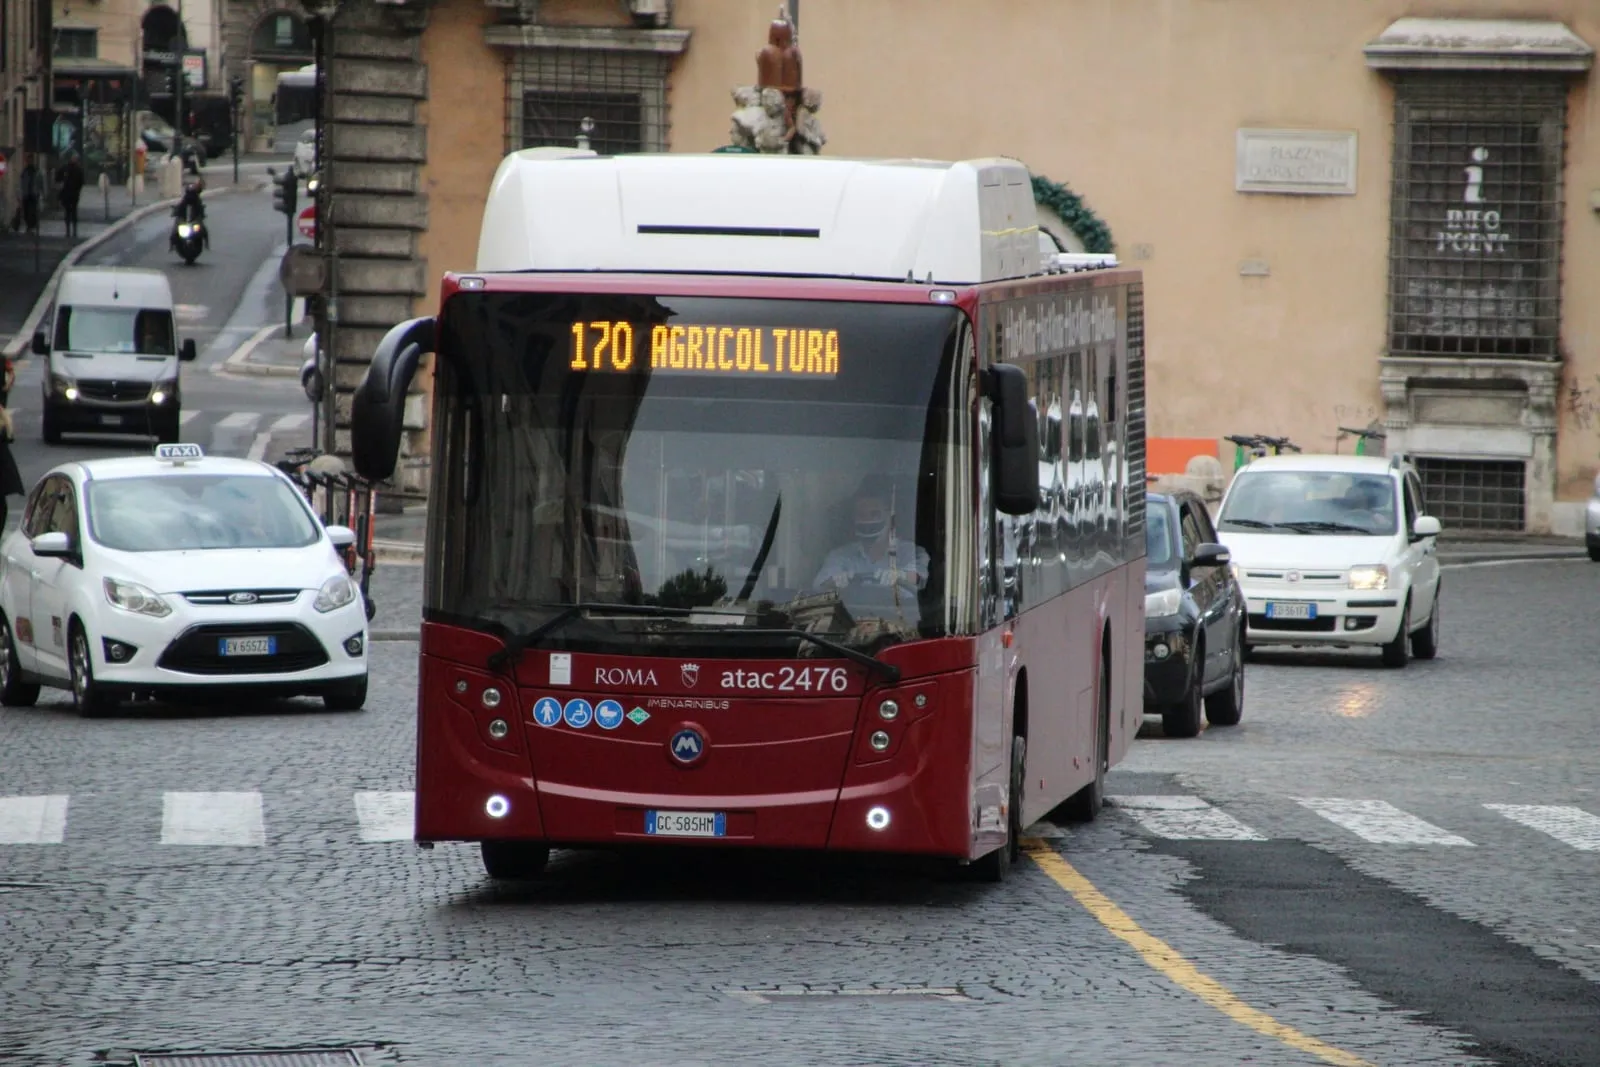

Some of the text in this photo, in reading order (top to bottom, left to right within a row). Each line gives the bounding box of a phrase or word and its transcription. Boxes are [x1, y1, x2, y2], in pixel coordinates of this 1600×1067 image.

[1436, 232, 1510, 253] POINT
[571, 321, 838, 373] 170 AGRICOLTURA
[164, 446, 197, 457] TAXI
[595, 667, 659, 686] ROMA
[720, 667, 848, 692] atac 2476
